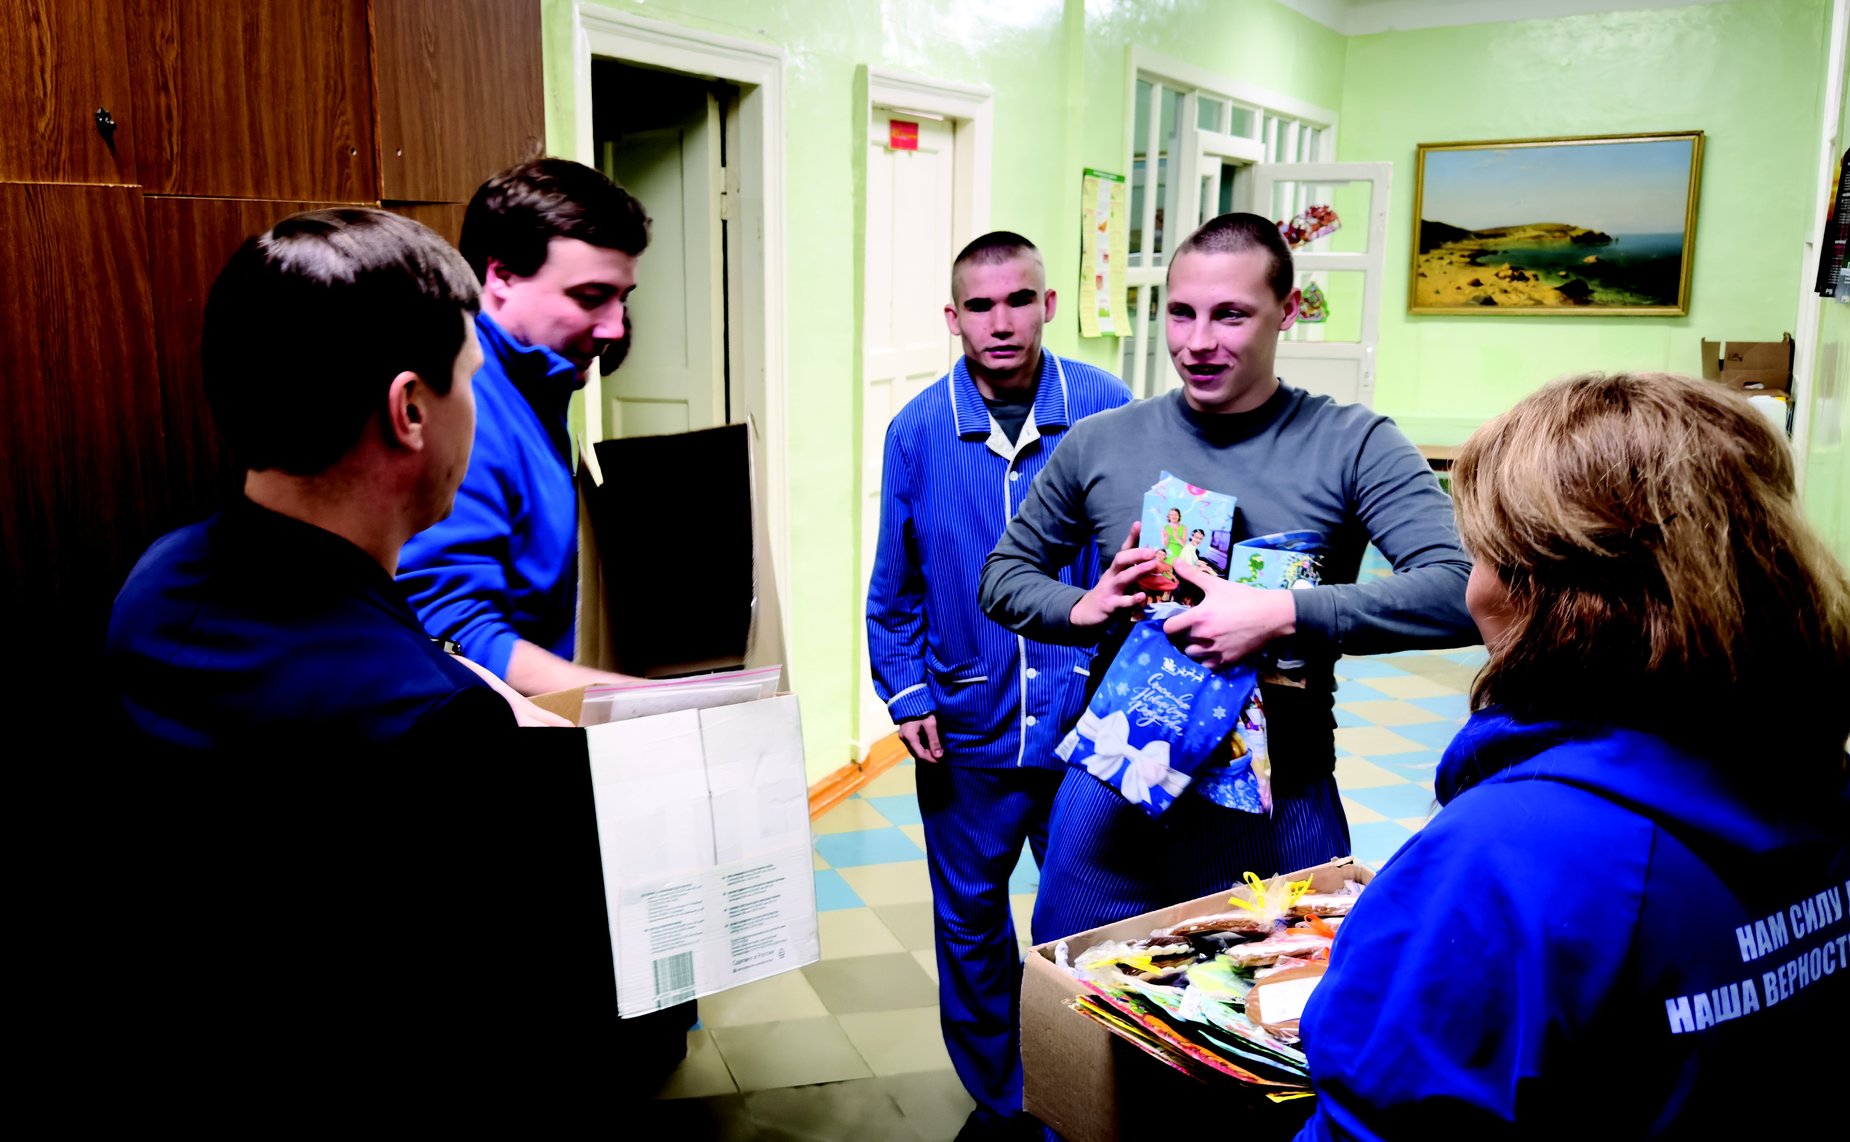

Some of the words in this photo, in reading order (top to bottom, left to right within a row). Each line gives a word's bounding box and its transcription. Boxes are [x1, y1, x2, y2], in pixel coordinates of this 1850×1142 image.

[1735, 911, 1789, 963] НАМ
[1789, 886, 1842, 940] СИЛУ
[1665, 978, 1760, 1034] НАША
[1763, 932, 1850, 1007] ВЕРНОСТ
